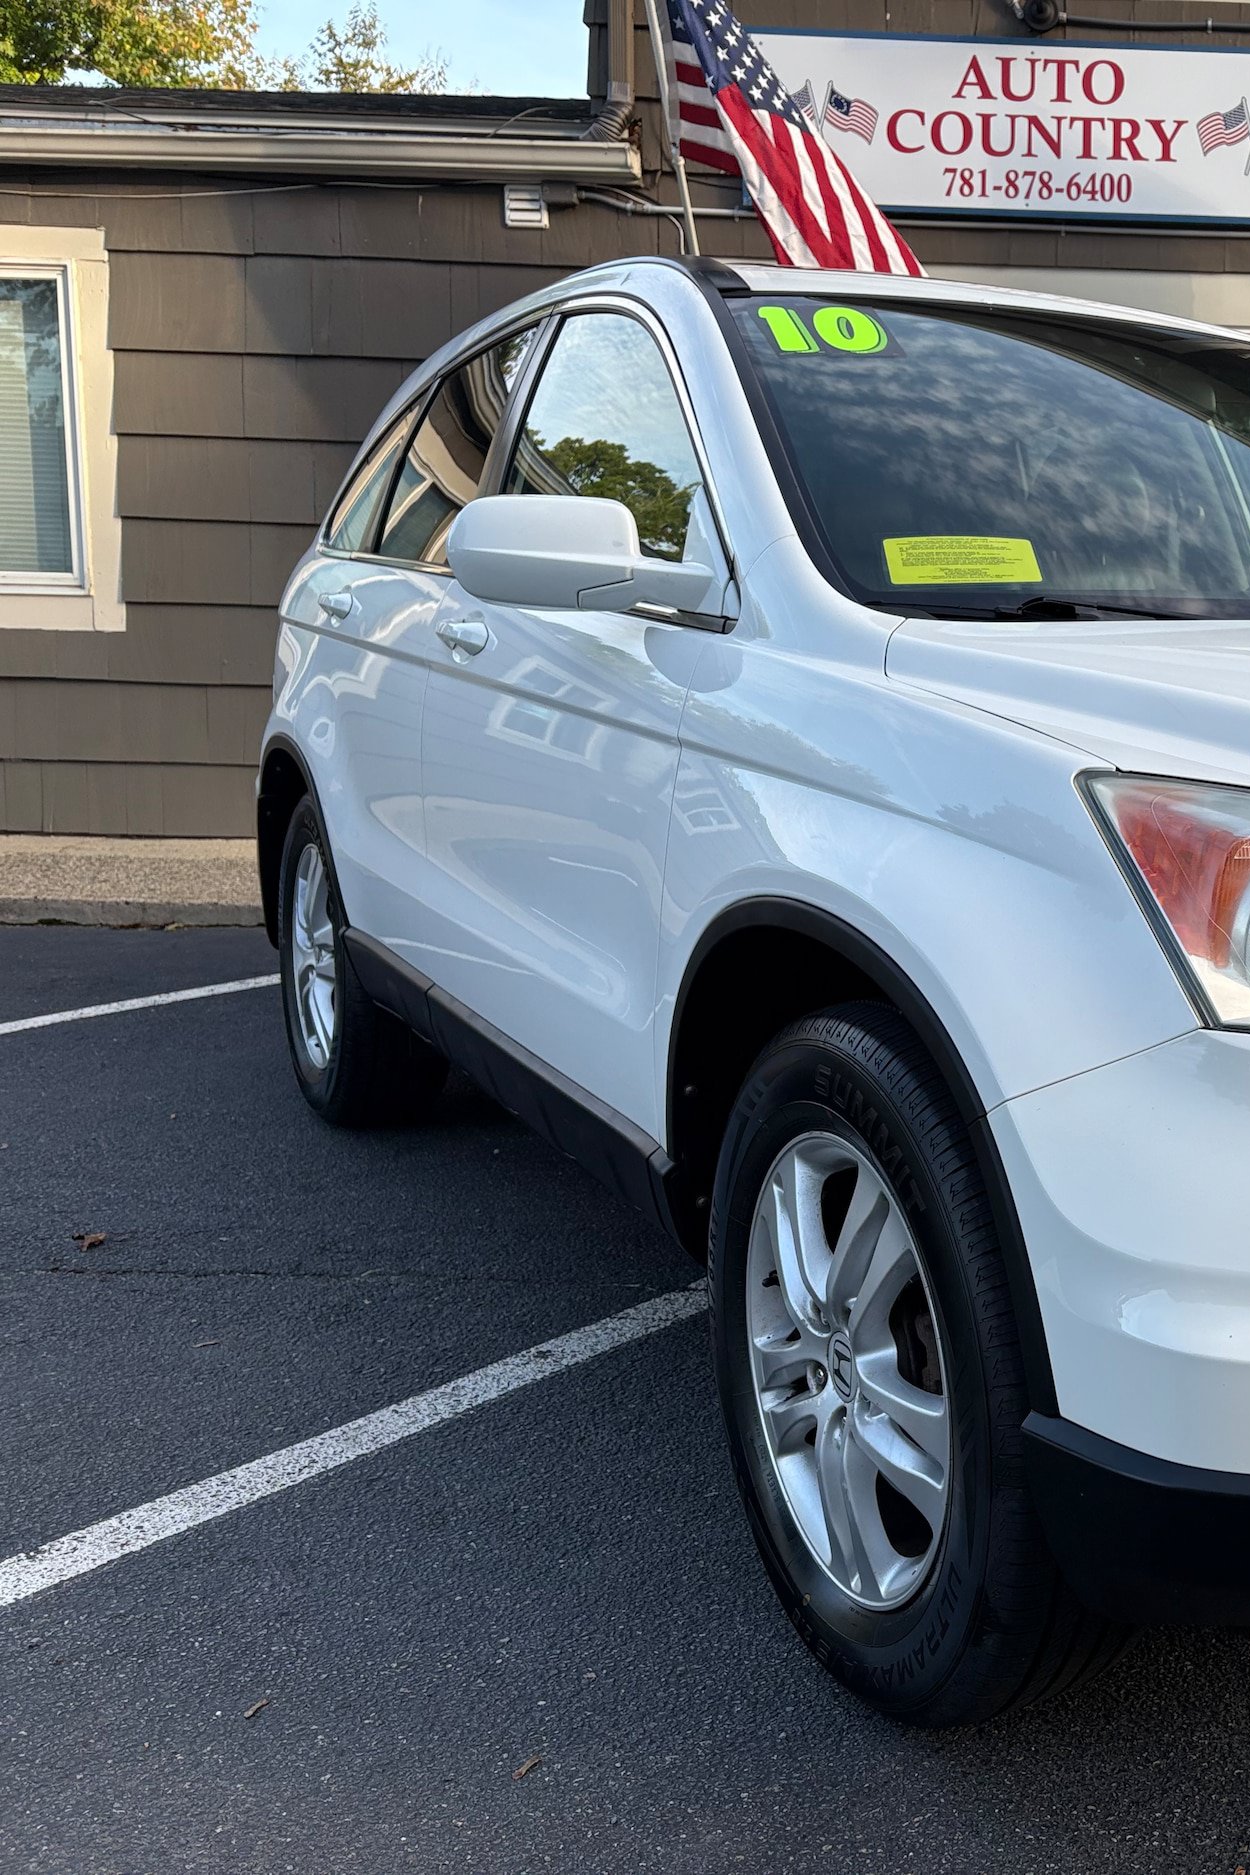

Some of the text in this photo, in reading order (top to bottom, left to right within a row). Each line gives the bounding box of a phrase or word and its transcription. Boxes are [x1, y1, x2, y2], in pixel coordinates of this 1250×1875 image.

[951, 54, 1125, 106] AUTO
[886, 108, 1189, 163] COUNTRY
[942, 167, 1132, 203] 781-878-6400
[757, 306, 888, 354] 10
[812, 1062, 928, 1214] SUMMIT
[863, 1560, 963, 1690] ULTRAMAX
